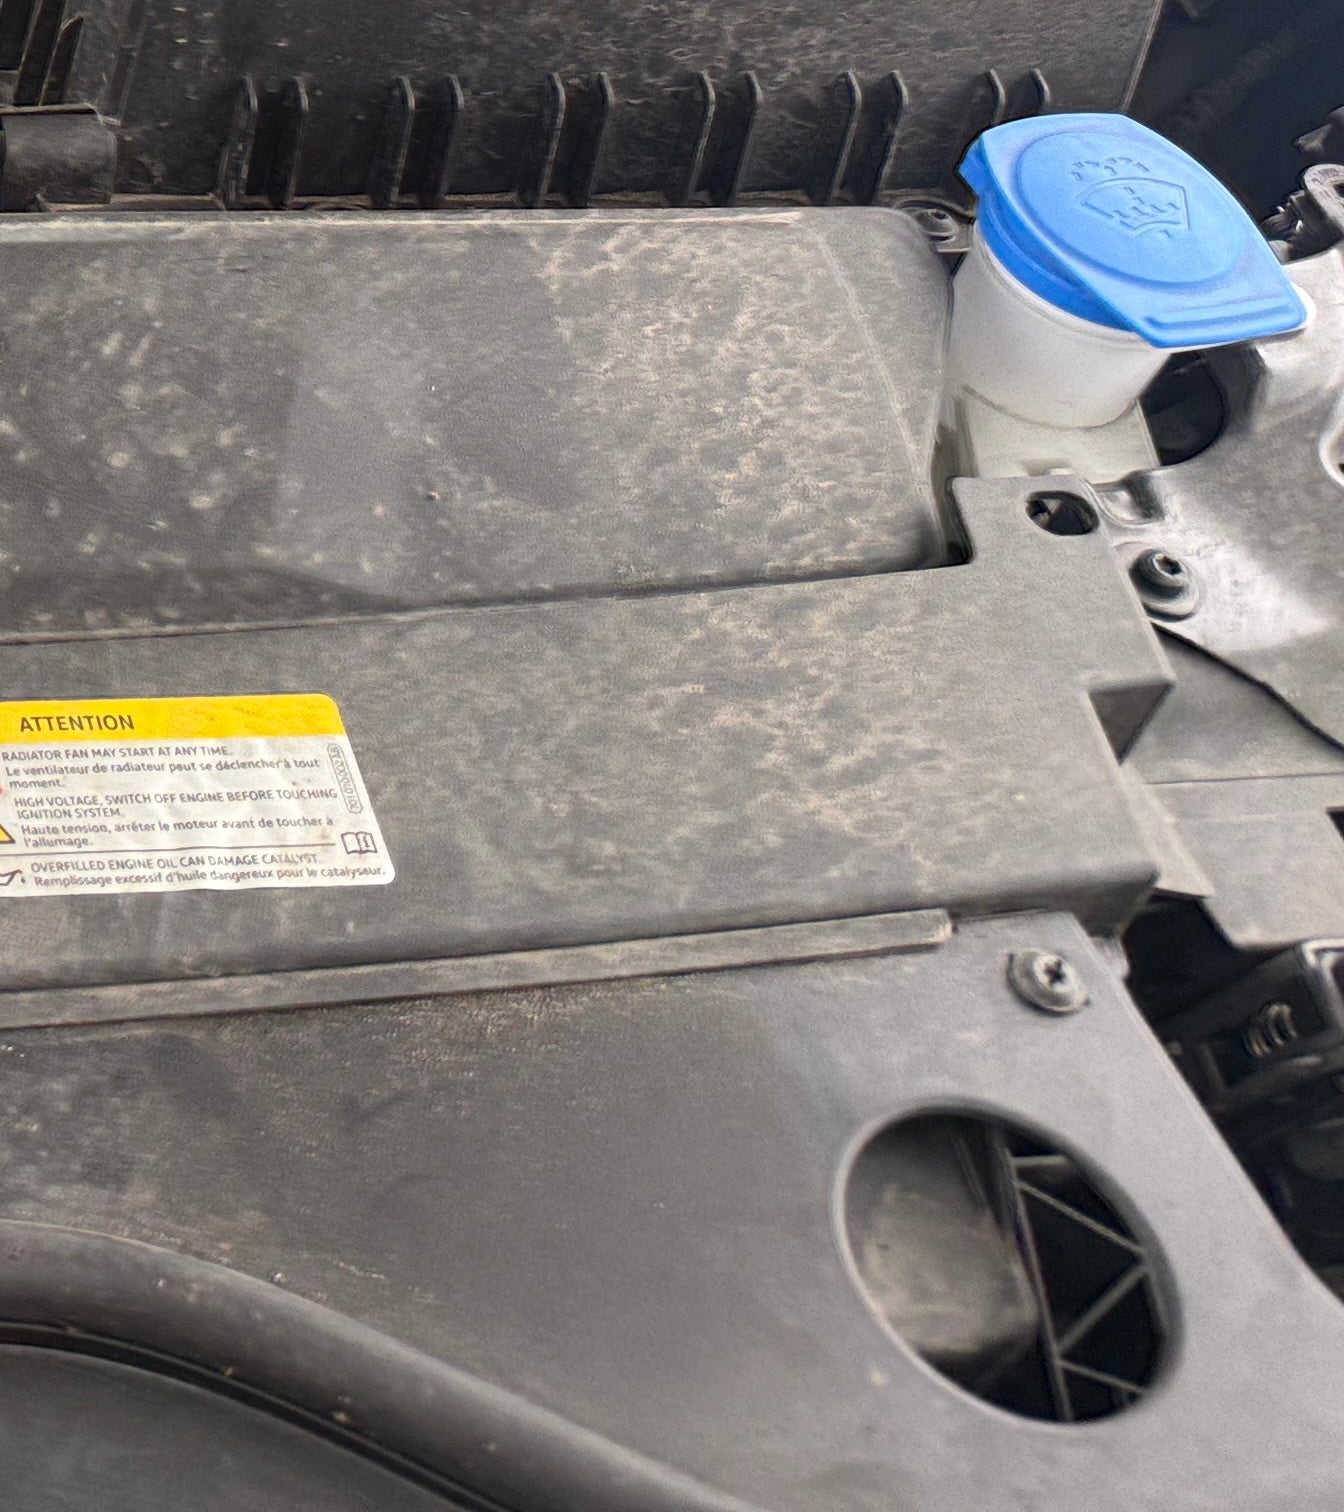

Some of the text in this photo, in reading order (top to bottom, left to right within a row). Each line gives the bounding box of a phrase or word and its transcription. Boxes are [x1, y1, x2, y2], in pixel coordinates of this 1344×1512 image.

[20, 715, 134, 733] ATTENTION
[2, 745, 197, 762] RADIATOR FAN MAY START AT ANY
[5, 758, 320, 777] Le ventilateur de radiateur peut se déclencher à tout
[14, 796, 44, 807] HIGH
[105, 793, 151, 805] SWITCH
[154, 793, 176, 804] OFF
[180, 792, 225, 803] ENGINE
[227, 791, 274, 802] BEFORE
[275, 788, 338, 800] TOUCHING
[17, 809, 72, 820] IGNITION
[21, 824, 59, 835] Haute
[158, 820, 170, 831] le
[173, 820, 217, 831] moteur
[221, 819, 256, 829] avant
[258, 818, 274, 828] de
[276, 817, 323, 827] toucher
[326, 817, 334, 826] à
[31, 861, 105, 873] OVERFILLED
[109, 859, 153, 870] ENGINE
[157, 858, 177, 869] OIL
[180, 856, 205, 867] CAN
[208, 855, 259, 866] DAMAGE
[115, 873, 163, 884] excessif
[210, 870, 272, 883] dangereux
[277, 870, 304, 880] pour
[306, 869, 318, 878] le
